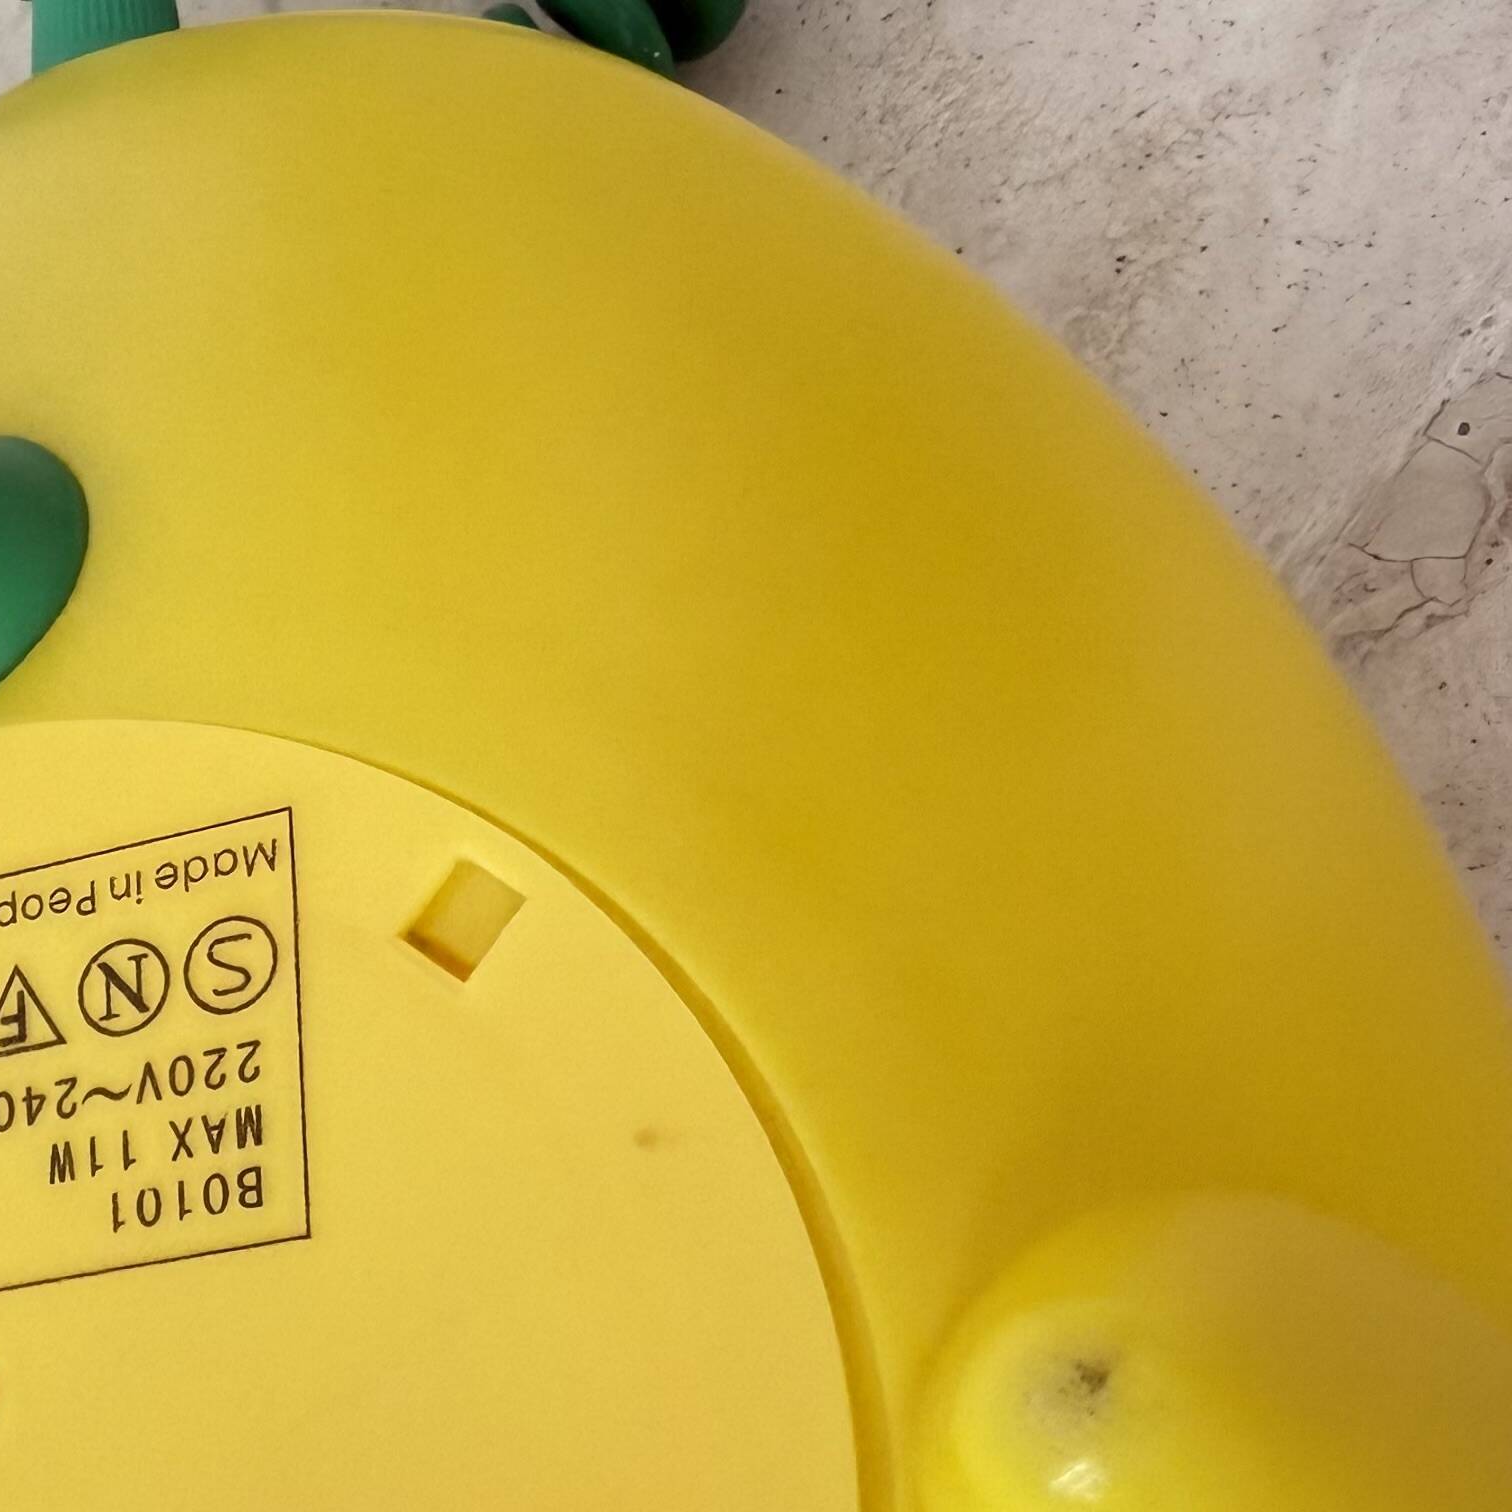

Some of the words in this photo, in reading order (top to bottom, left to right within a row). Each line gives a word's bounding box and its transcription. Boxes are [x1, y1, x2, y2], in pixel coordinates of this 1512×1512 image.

[109, 869, 145, 905] in
[154, 837, 278, 893] Made
[49, 1129, 137, 1185] 11W
[168, 1103, 265, 1163] MAX
